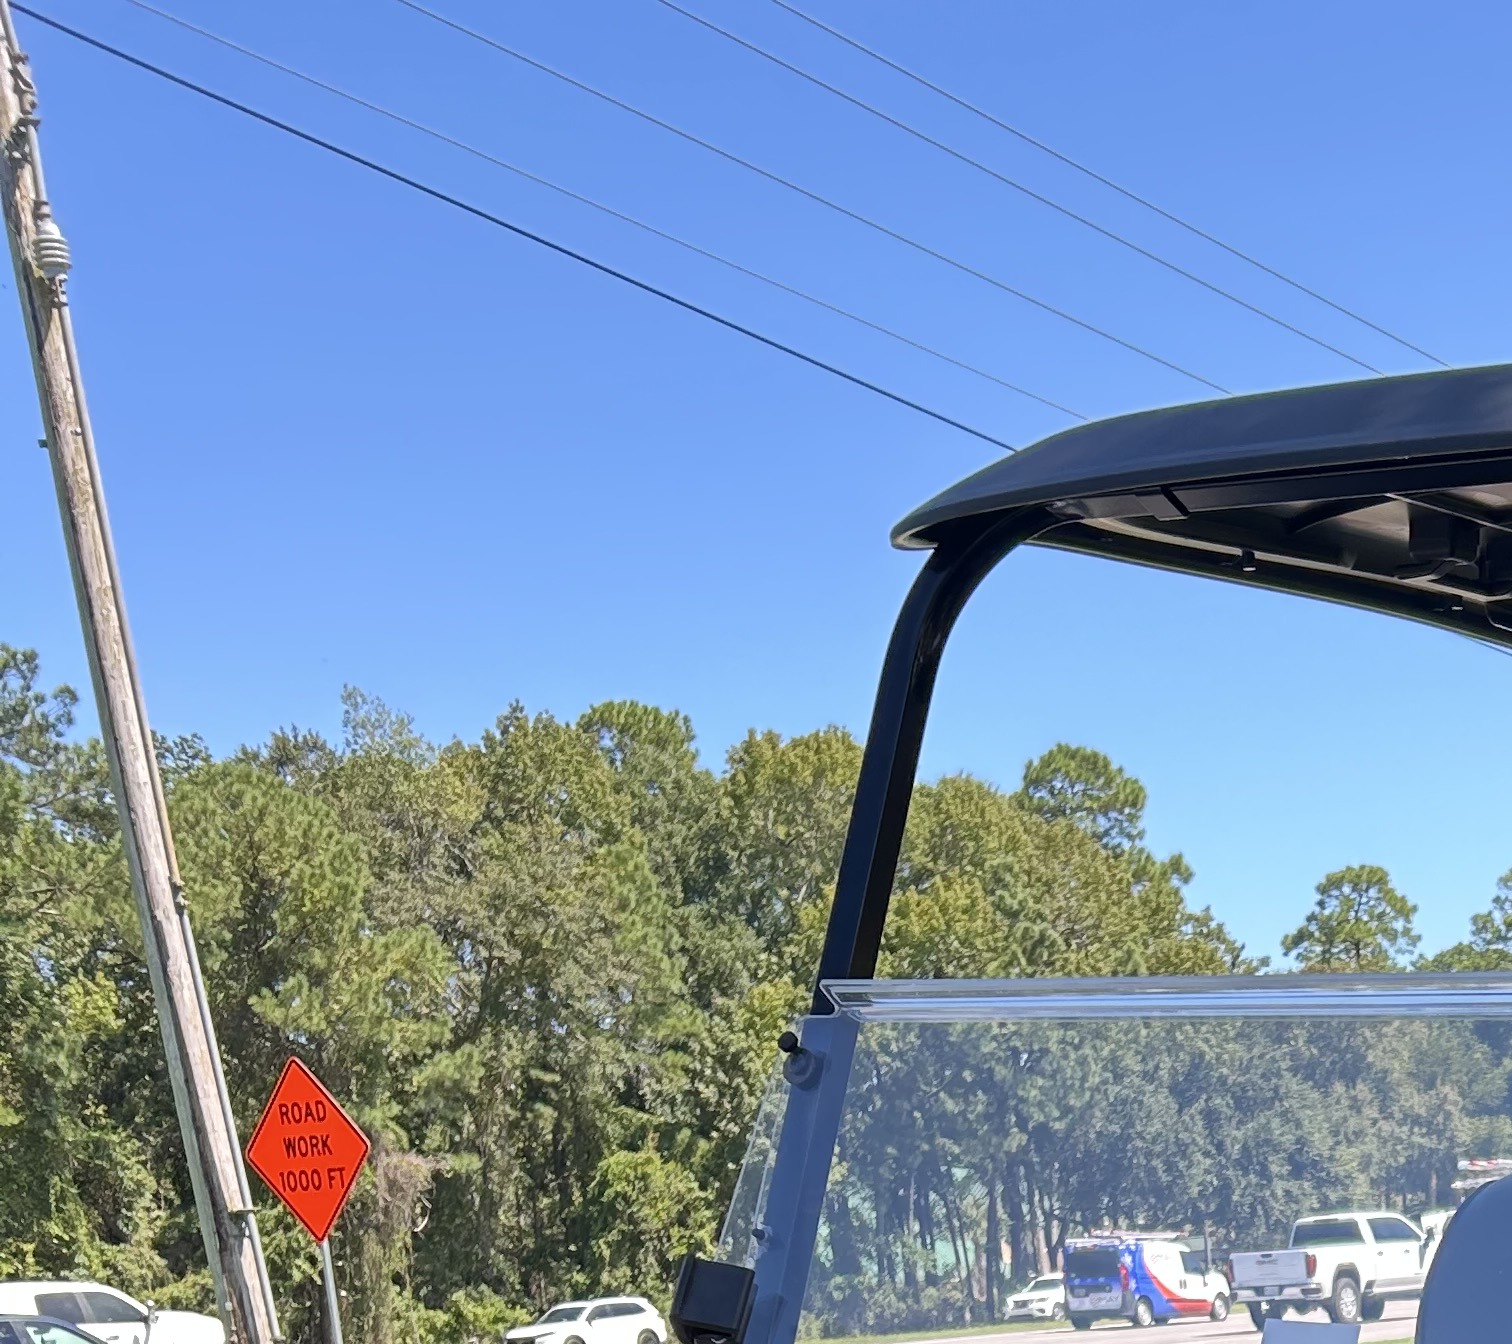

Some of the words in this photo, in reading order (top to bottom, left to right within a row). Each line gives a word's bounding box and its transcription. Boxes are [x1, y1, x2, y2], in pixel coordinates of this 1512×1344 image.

[278, 1100, 327, 1126] ROAD
[283, 1134, 333, 1159] WORK
[279, 1168, 322, 1193] 1000
[327, 1166, 346, 1190] FT
